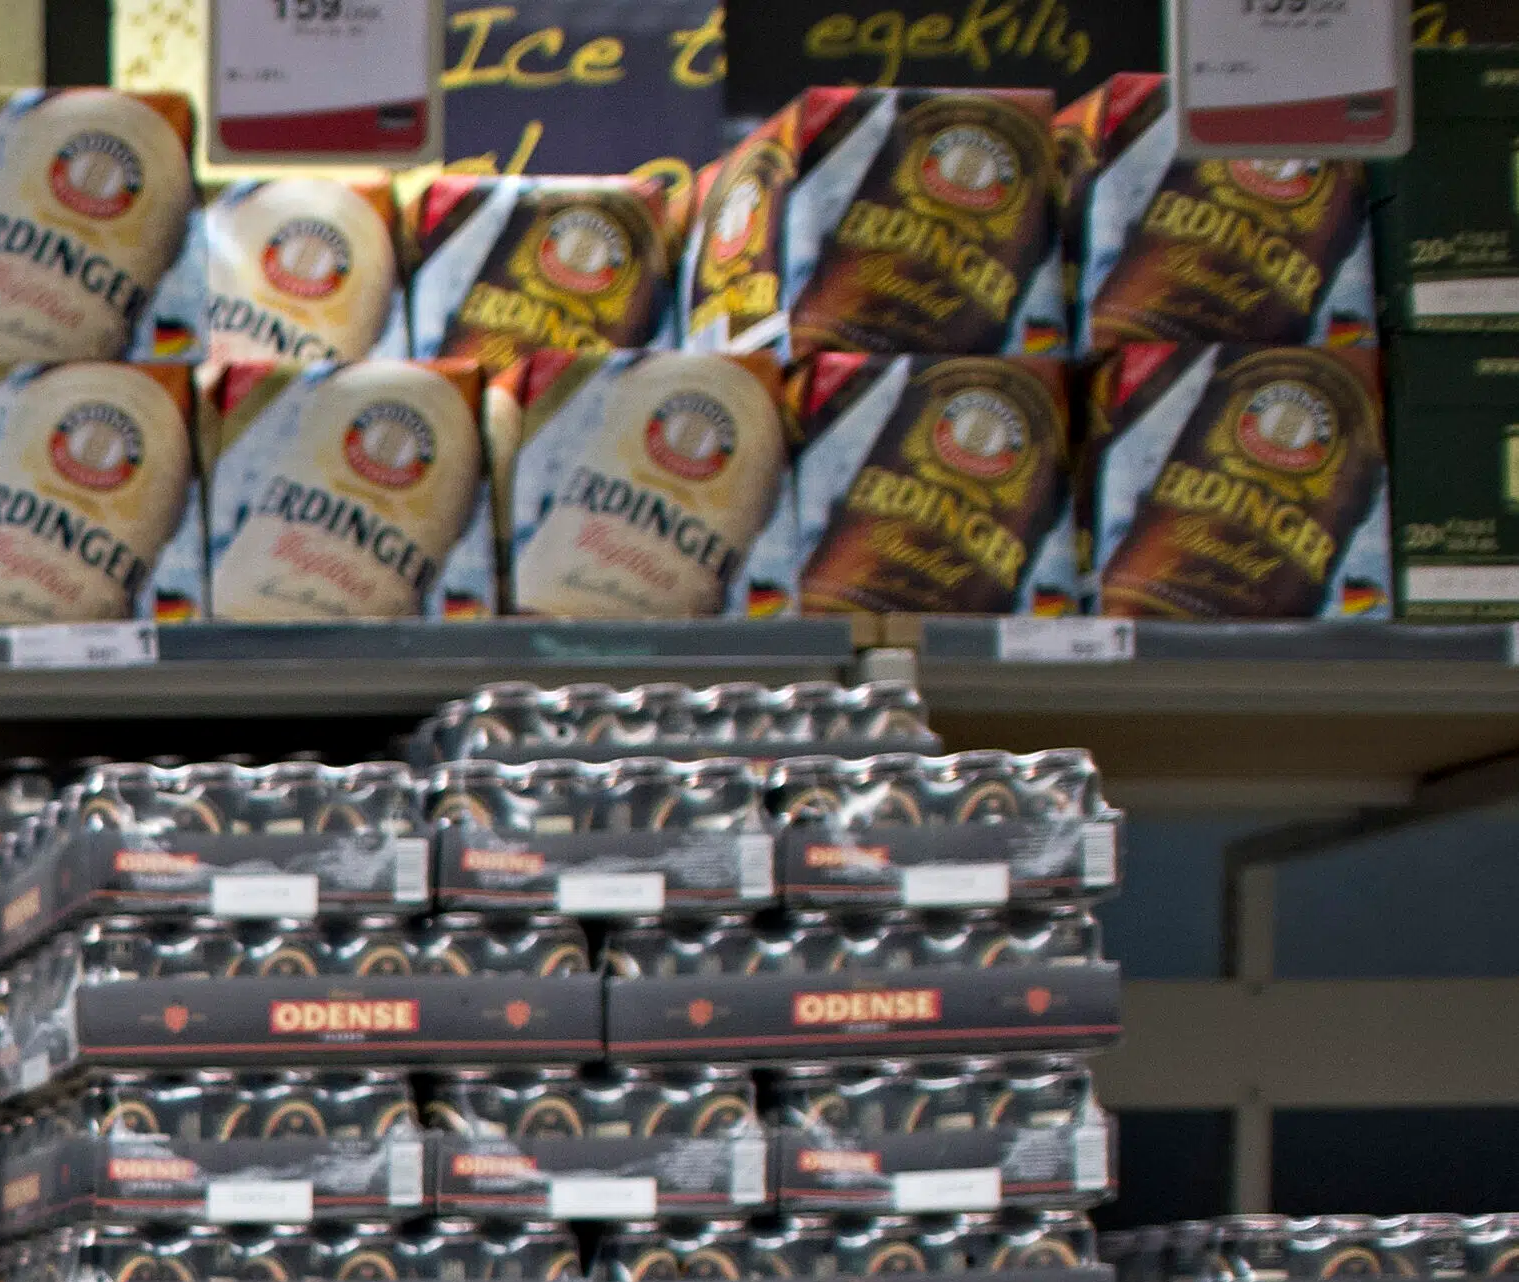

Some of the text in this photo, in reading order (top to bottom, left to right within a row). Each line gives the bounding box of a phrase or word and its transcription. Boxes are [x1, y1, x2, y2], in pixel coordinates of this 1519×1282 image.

[441, 6, 627, 88] Ice
[837, 199, 1019, 323] ERDINGER
[1144, 190, 1324, 314] ERDINGER
[851, 464, 1029, 588] ERDINGER
[1157, 460, 1337, 584] ERDINGER
[273, 1002, 413, 1030] ODENSE
[797, 993, 936, 1022] ODENSE
